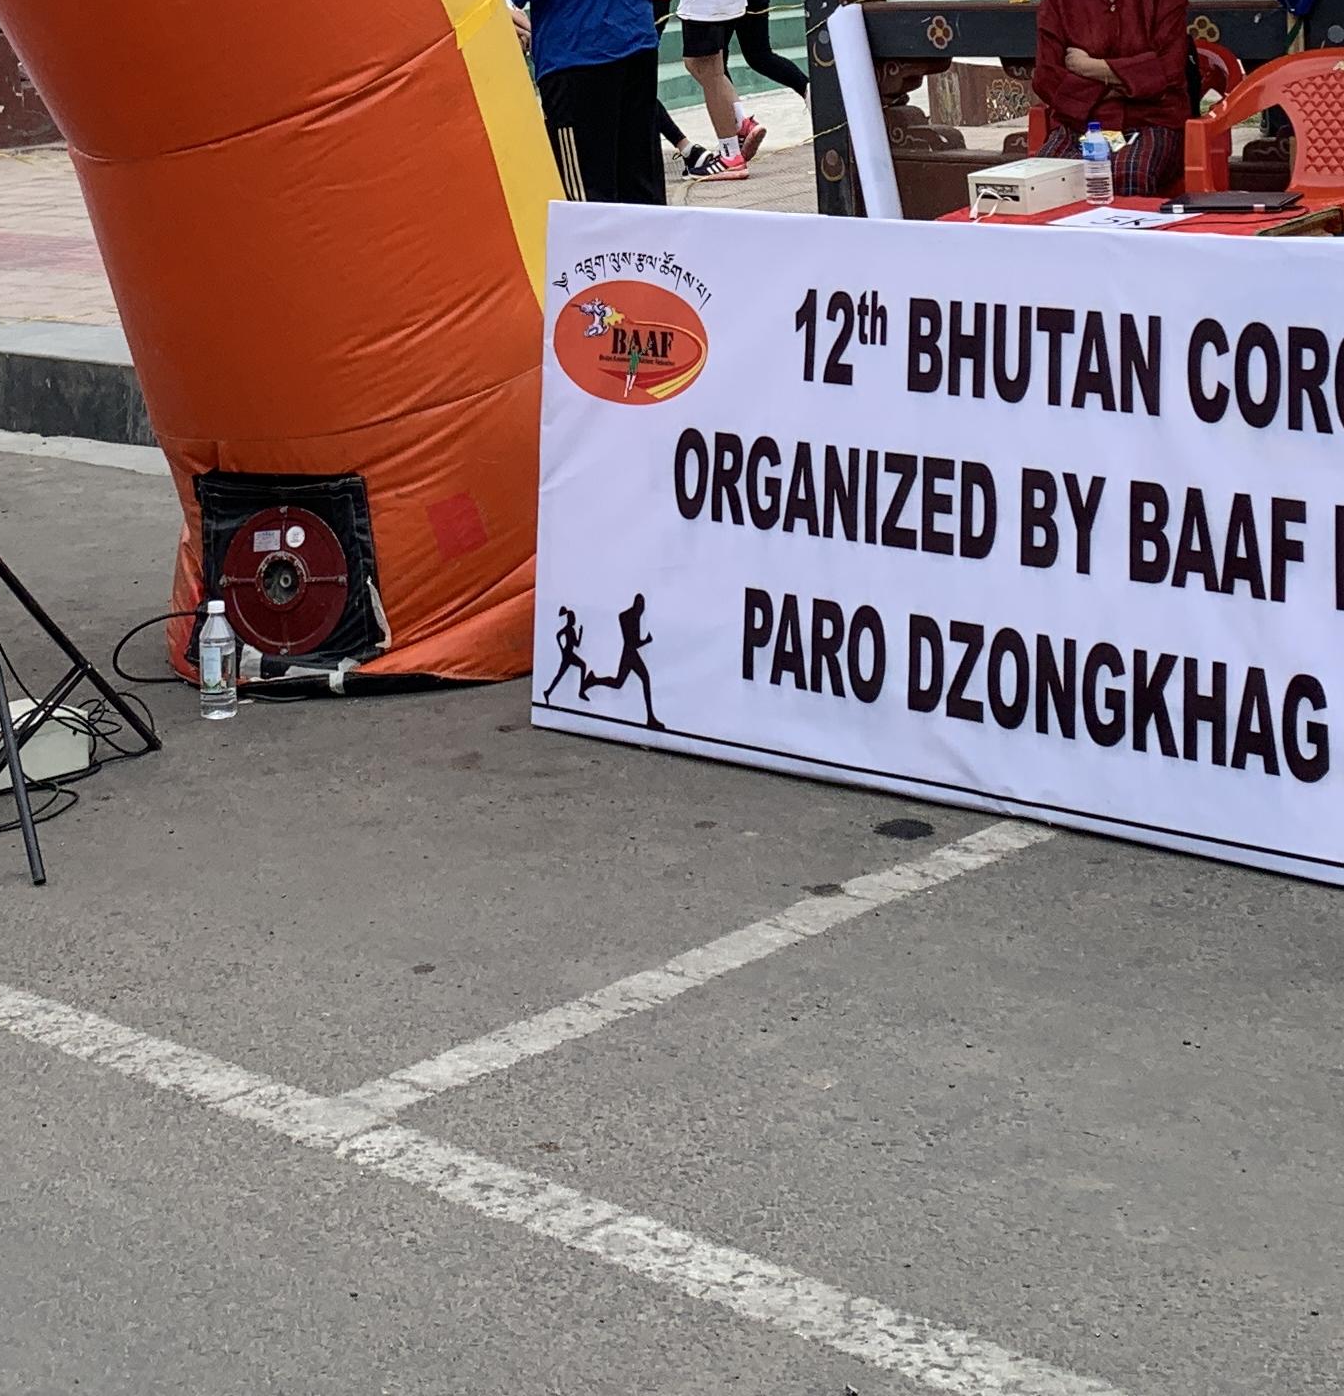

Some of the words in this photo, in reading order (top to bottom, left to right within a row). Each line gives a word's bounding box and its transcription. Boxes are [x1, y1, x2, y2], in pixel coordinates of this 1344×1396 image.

[1089, 215, 1163, 226] 5K
[611, 327, 675, 359] BAAF
[794, 287, 888, 386] 12th
[907, 296, 1162, 417] BHUTAN
[673, 427, 998, 560] ORGANIZED
[1019, 467, 1106, 576] BY
[1129, 479, 1307, 603] BAAF
[741, 586, 887, 705] PARO
[907, 613, 1331, 784] DZONGKHAG
